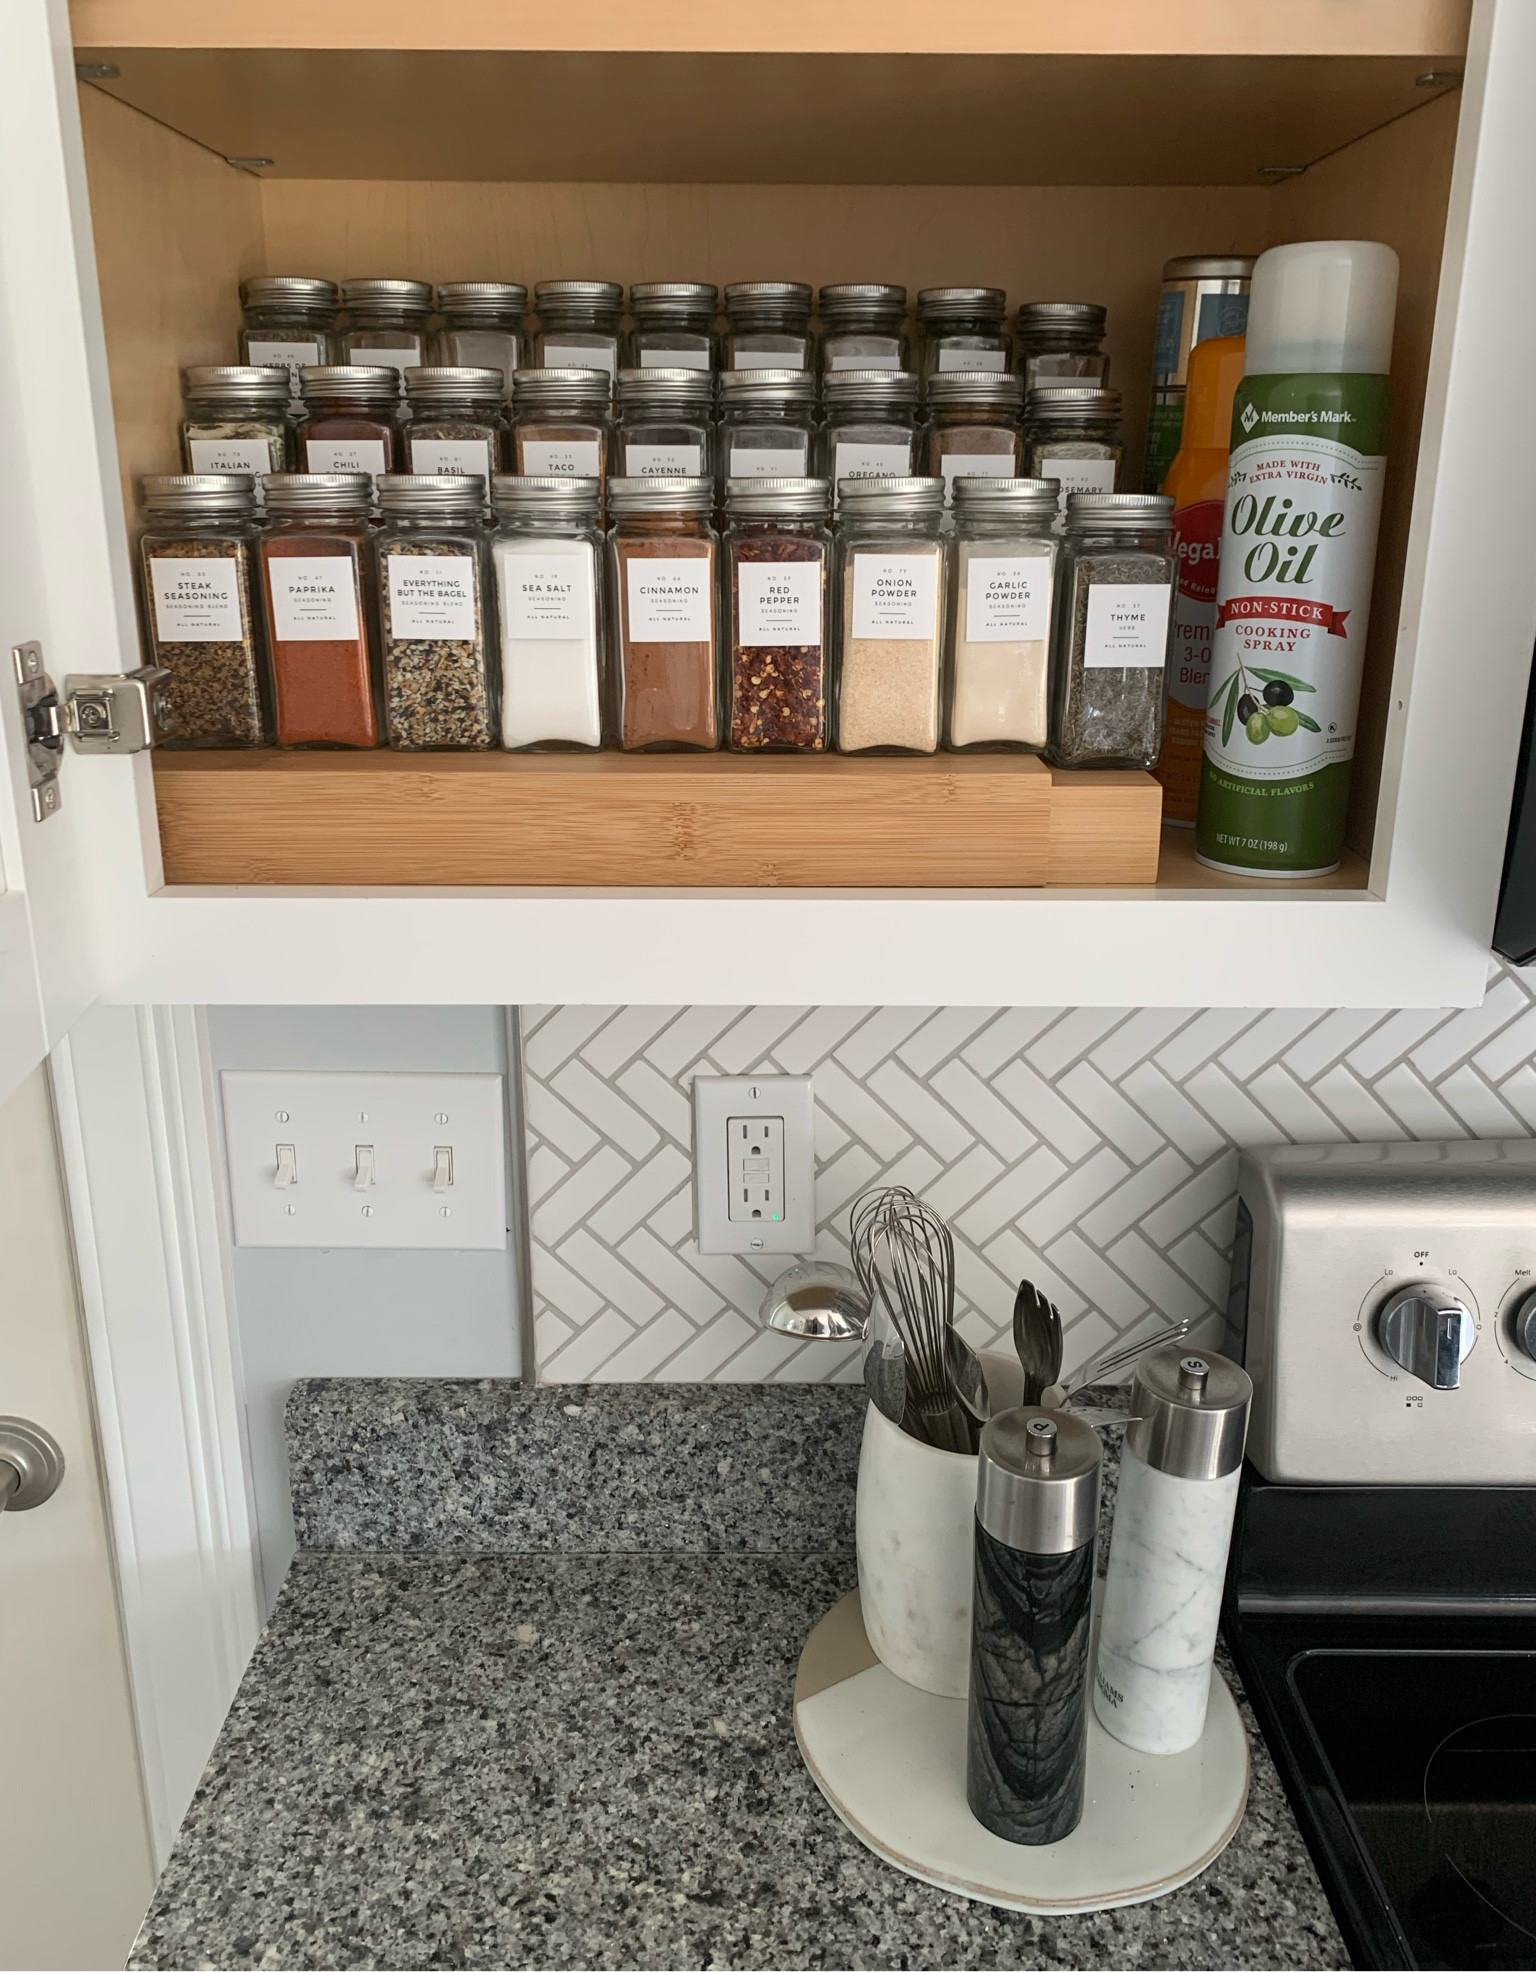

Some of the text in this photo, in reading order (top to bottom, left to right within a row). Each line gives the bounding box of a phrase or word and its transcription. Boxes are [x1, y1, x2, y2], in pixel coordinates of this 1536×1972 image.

[1261, 411, 1352, 423] Member's Mark
[333, 461, 360, 469] CHILI
[548, 463, 575, 471] TACO
[1256, 460, 1321, 472] MADE WITH
[437, 466, 466, 474] BASIL
[641, 466, 687, 474] CAYENNE
[848, 470, 896, 478] OREGANO
[1249, 470, 1329, 485] EXTRA VIRGIN
[1059, 486, 1104, 494] OSEMARY
[1230, 493, 1347, 538] Olive
[1244, 541, 1319, 585] Oil
[177, 582, 213, 590] STEAK
[403, 579, 461, 588] EVERYTHING
[876, 578, 913, 587] ONION
[989, 581, 1028, 590] GARLIC
[288, 586, 336, 594] PAPRIKA
[522, 584, 572, 592] SEA SALT
[639, 586, 699, 595] CINNAMON
[769, 586, 790, 594] RED
[163, 592, 228, 600] SEASONING
[397, 589, 467, 598] BUT THE BAGEL
[871, 589, 917, 597] POWDER
[985, 591, 1031, 600] POWDER
[759, 596, 800, 604] PEPPER
[1230, 601, 1324, 620] NON-STICK
[1110, 614, 1146, 622] THYME
[1235, 624, 1312, 639] COOKING
[1243, 638, 1297, 652] SPRAY
[1209, 770, 1217, 781] NO
[1217, 778, 1268, 796] ARTIFICIAL
[1270, 781, 1315, 796] FLAVORS
[1216, 833, 1288, 853] NET WT 7 OZ (198 g)
[1384, 1268, 1394, 1276] Lo
[1448, 1268, 1458, 1276] Lo
[1514, 1269, 1531, 1277] Melt
[1187, 1360, 1203, 1369] S
[1032, 1421, 1050, 1432] P
